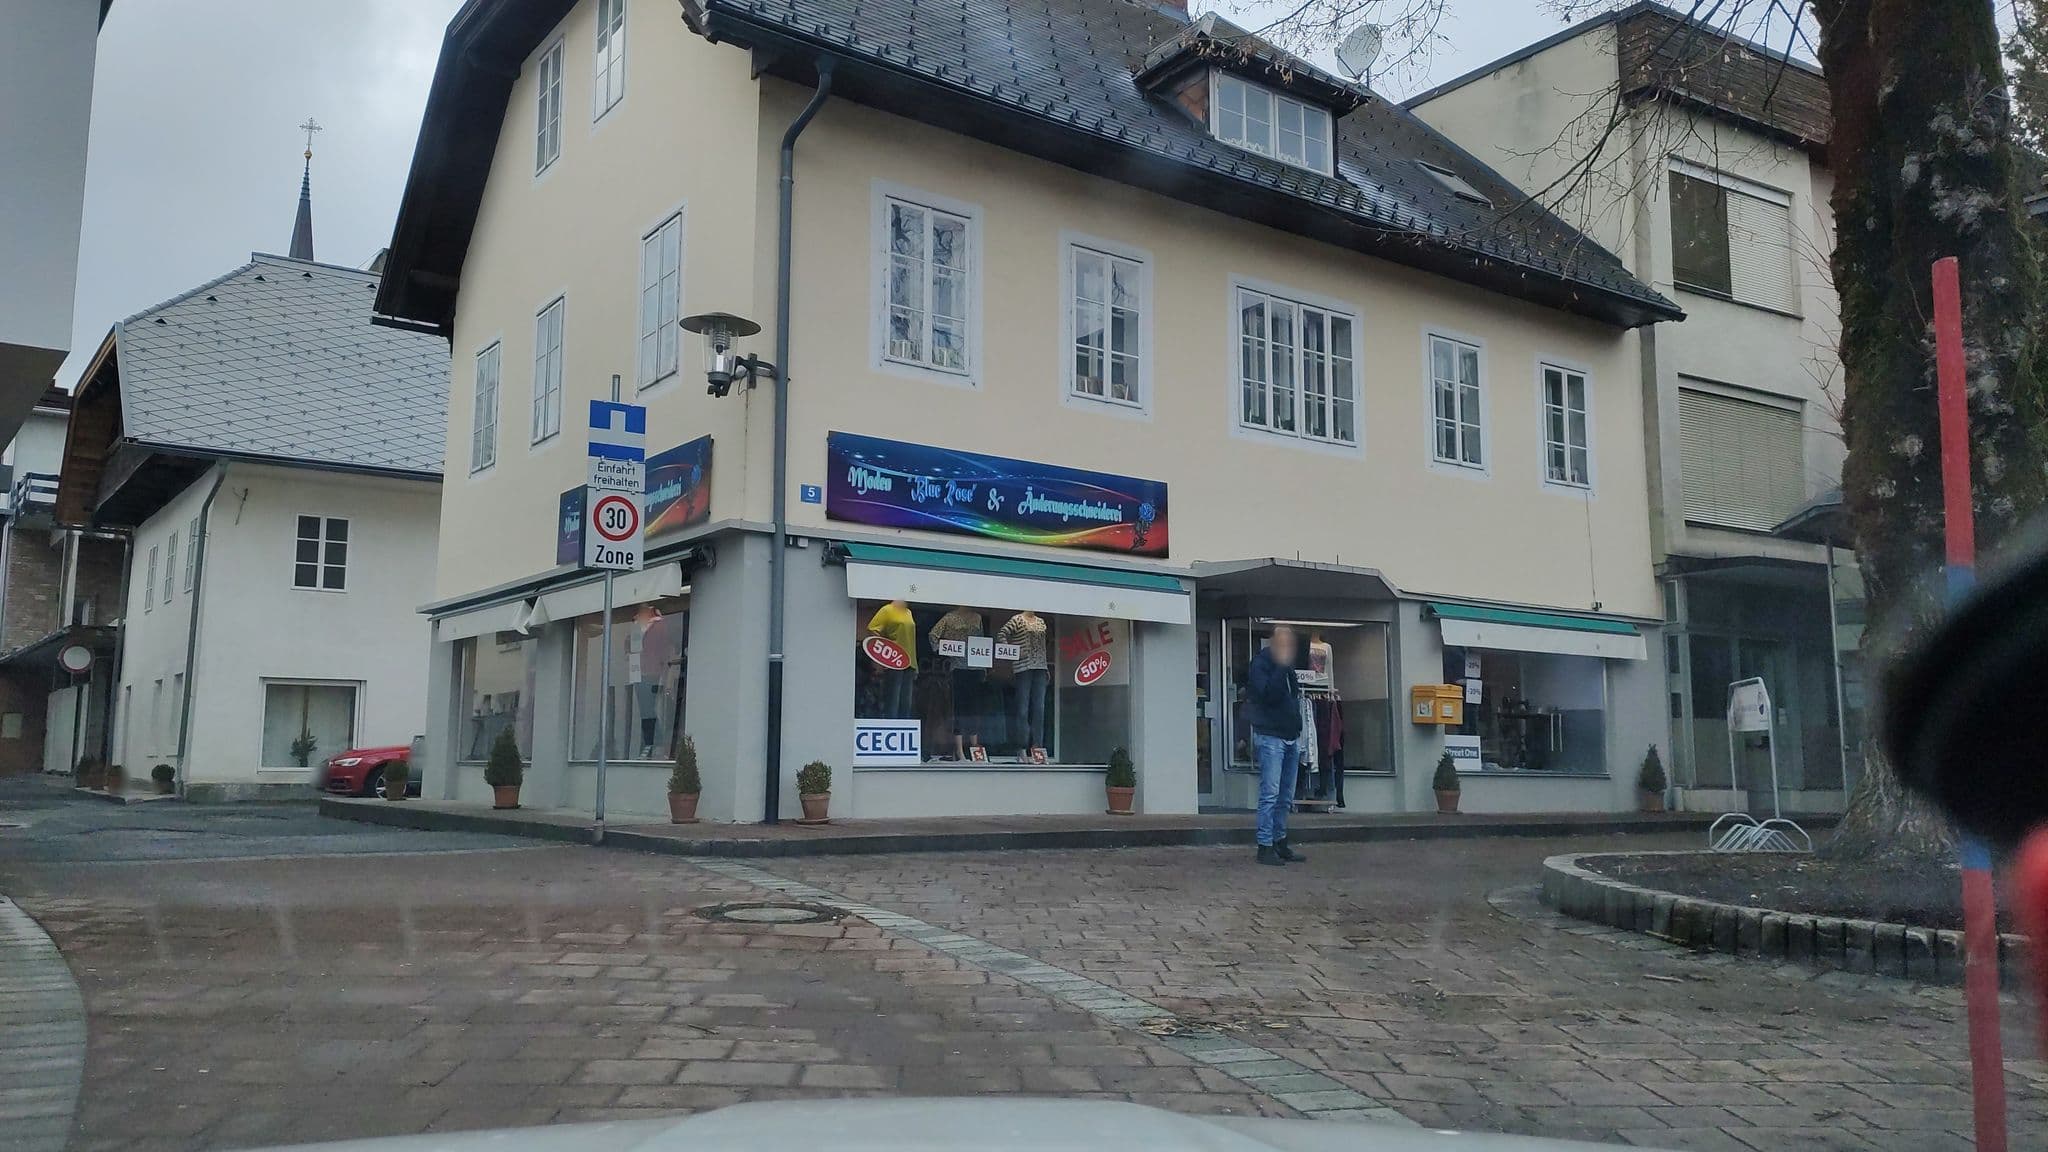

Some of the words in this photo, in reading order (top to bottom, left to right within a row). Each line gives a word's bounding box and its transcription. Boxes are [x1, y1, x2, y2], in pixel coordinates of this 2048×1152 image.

[597, 462, 636, 476] Einfahrt
[593, 474, 640, 488] freihalten
[848, 466, 893, 495] Moden
[987, 487, 1005, 511] &
[807, 487, 816, 498] 5
[606, 507, 627, 530] 30
[595, 545, 634, 565] Zone
[942, 643, 963, 654] SALE
[1058, 621, 1114, 661] SALE
[872, 639, 903, 668] 50%
[970, 647, 991, 657] SALE
[997, 647, 1018, 657] SALE
[1080, 656, 1108, 678] 50%
[855, 732, 918, 751] CECIL
